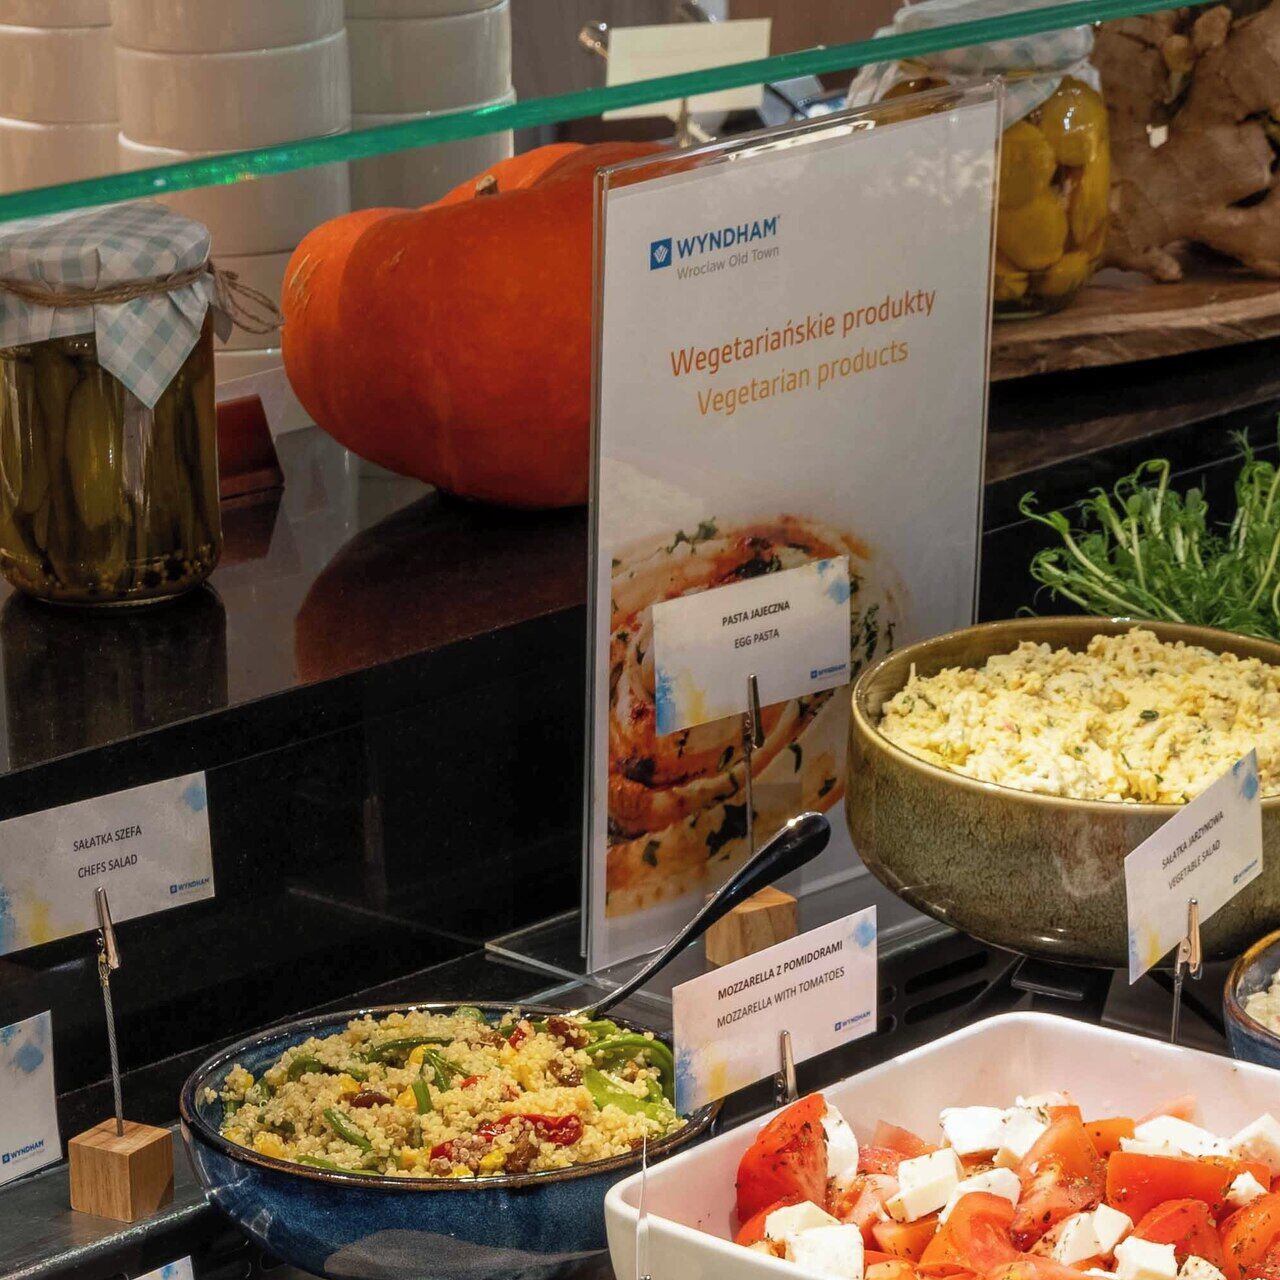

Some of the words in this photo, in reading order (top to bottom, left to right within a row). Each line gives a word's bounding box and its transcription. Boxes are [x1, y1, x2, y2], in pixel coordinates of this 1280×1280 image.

[676, 216, 778, 259] WYNDHAM
[729, 253, 748, 268] Old
[753, 246, 780, 262] Town
[670, 313, 835, 377] Wegetariańskie
[842, 290, 937, 338] produkty
[697, 368, 810, 416] Vegetarian
[818, 340, 909, 391] products
[722, 610, 749, 627] PASTA
[750, 600, 791, 620] JAJECZNA
[734, 635, 752, 649] EGG
[753, 628, 780, 644] PASTA
[73, 832, 113, 852] SAŁATKA
[114, 825, 142, 841] SZEFA
[78, 861, 107, 878] CHEFS
[108, 854, 138, 871] SALAD
[1168, 855, 1202, 890] VEGETABLE
[1202, 839, 1221, 862] SALAD
[717, 968, 775, 1000] MOZZARELLA
[776, 965, 782, 976] Z
[783, 940, 843, 973] POMIDORAMI
[716, 997, 773, 1028] MOZZARELLA
[774, 985, 797, 1003] WITH
[798, 966, 845, 994] TOMATOES
[9, 1140, 44, 1159] WYNDHAM
